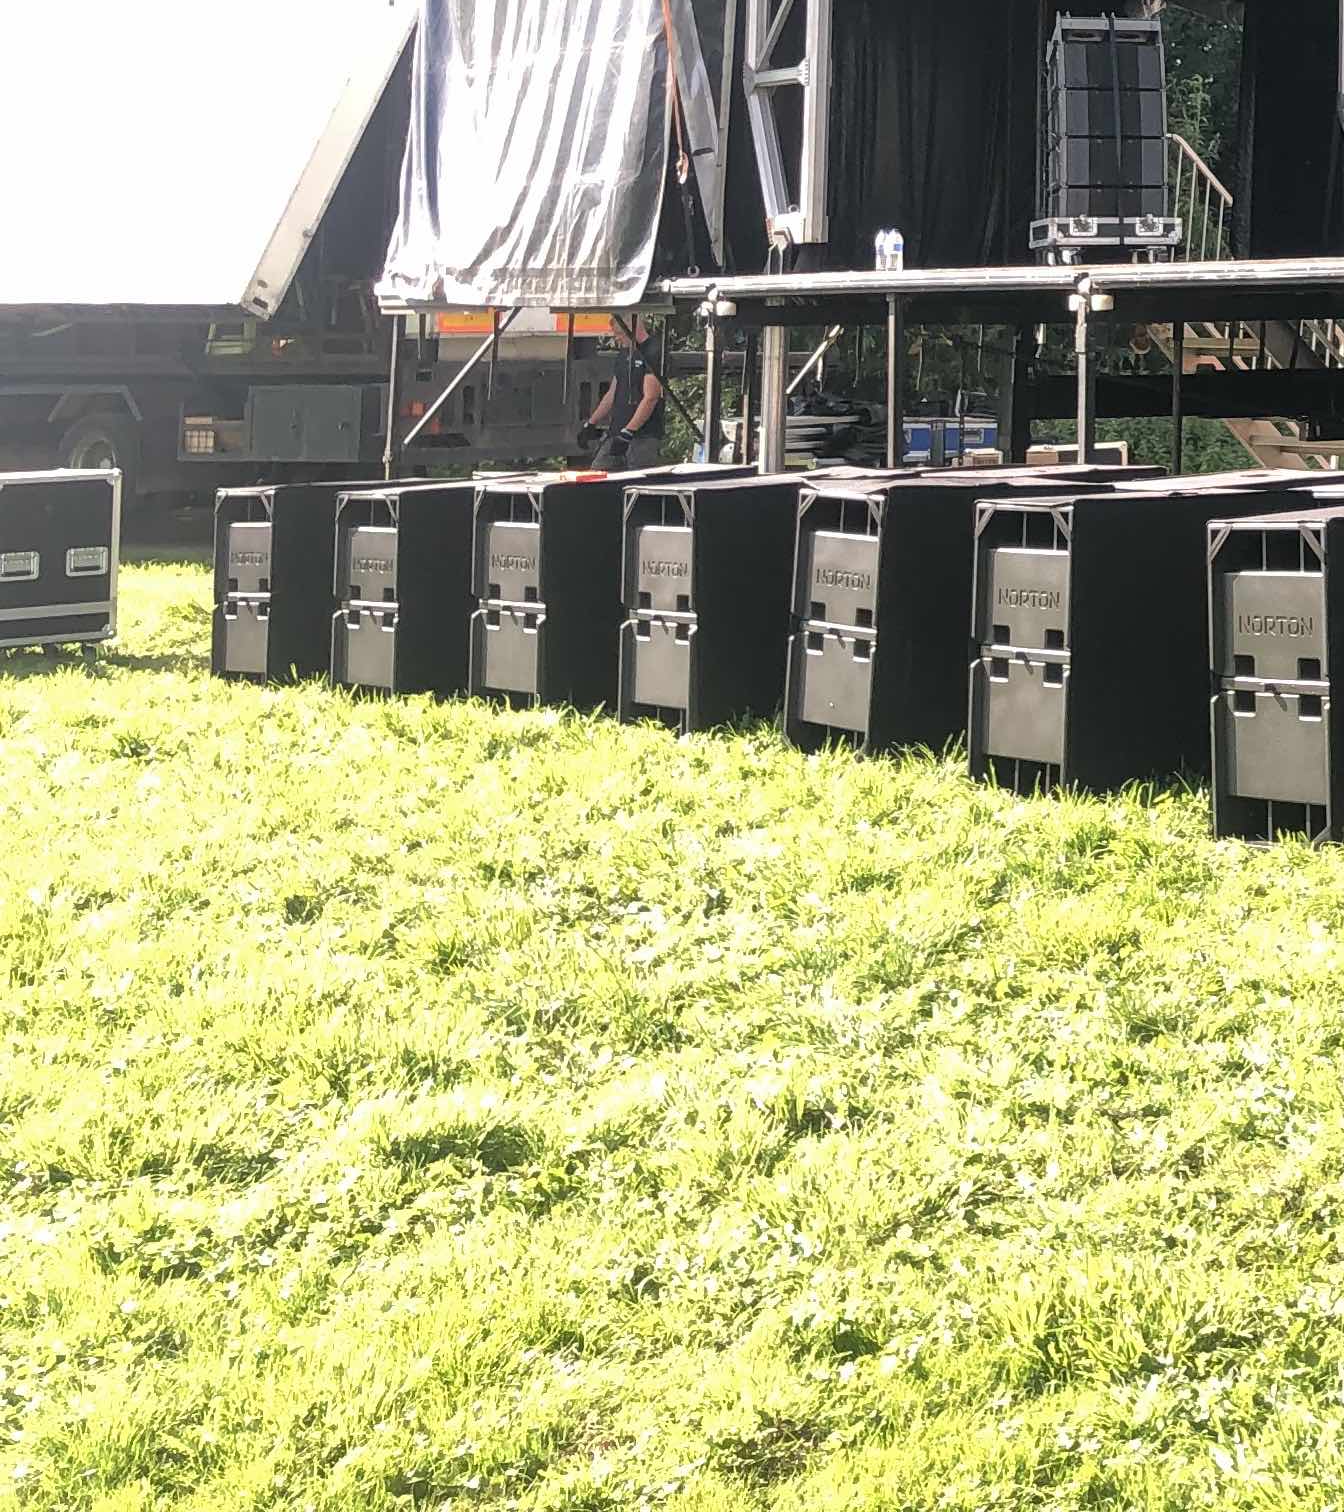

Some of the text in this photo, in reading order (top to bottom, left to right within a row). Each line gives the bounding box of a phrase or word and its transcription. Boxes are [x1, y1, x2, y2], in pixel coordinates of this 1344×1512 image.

[642, 560, 688, 578] NORTON
[816, 568, 871, 590] NORTON
[998, 588, 1060, 609] NORTON
[1238, 615, 1313, 638] NORTON
